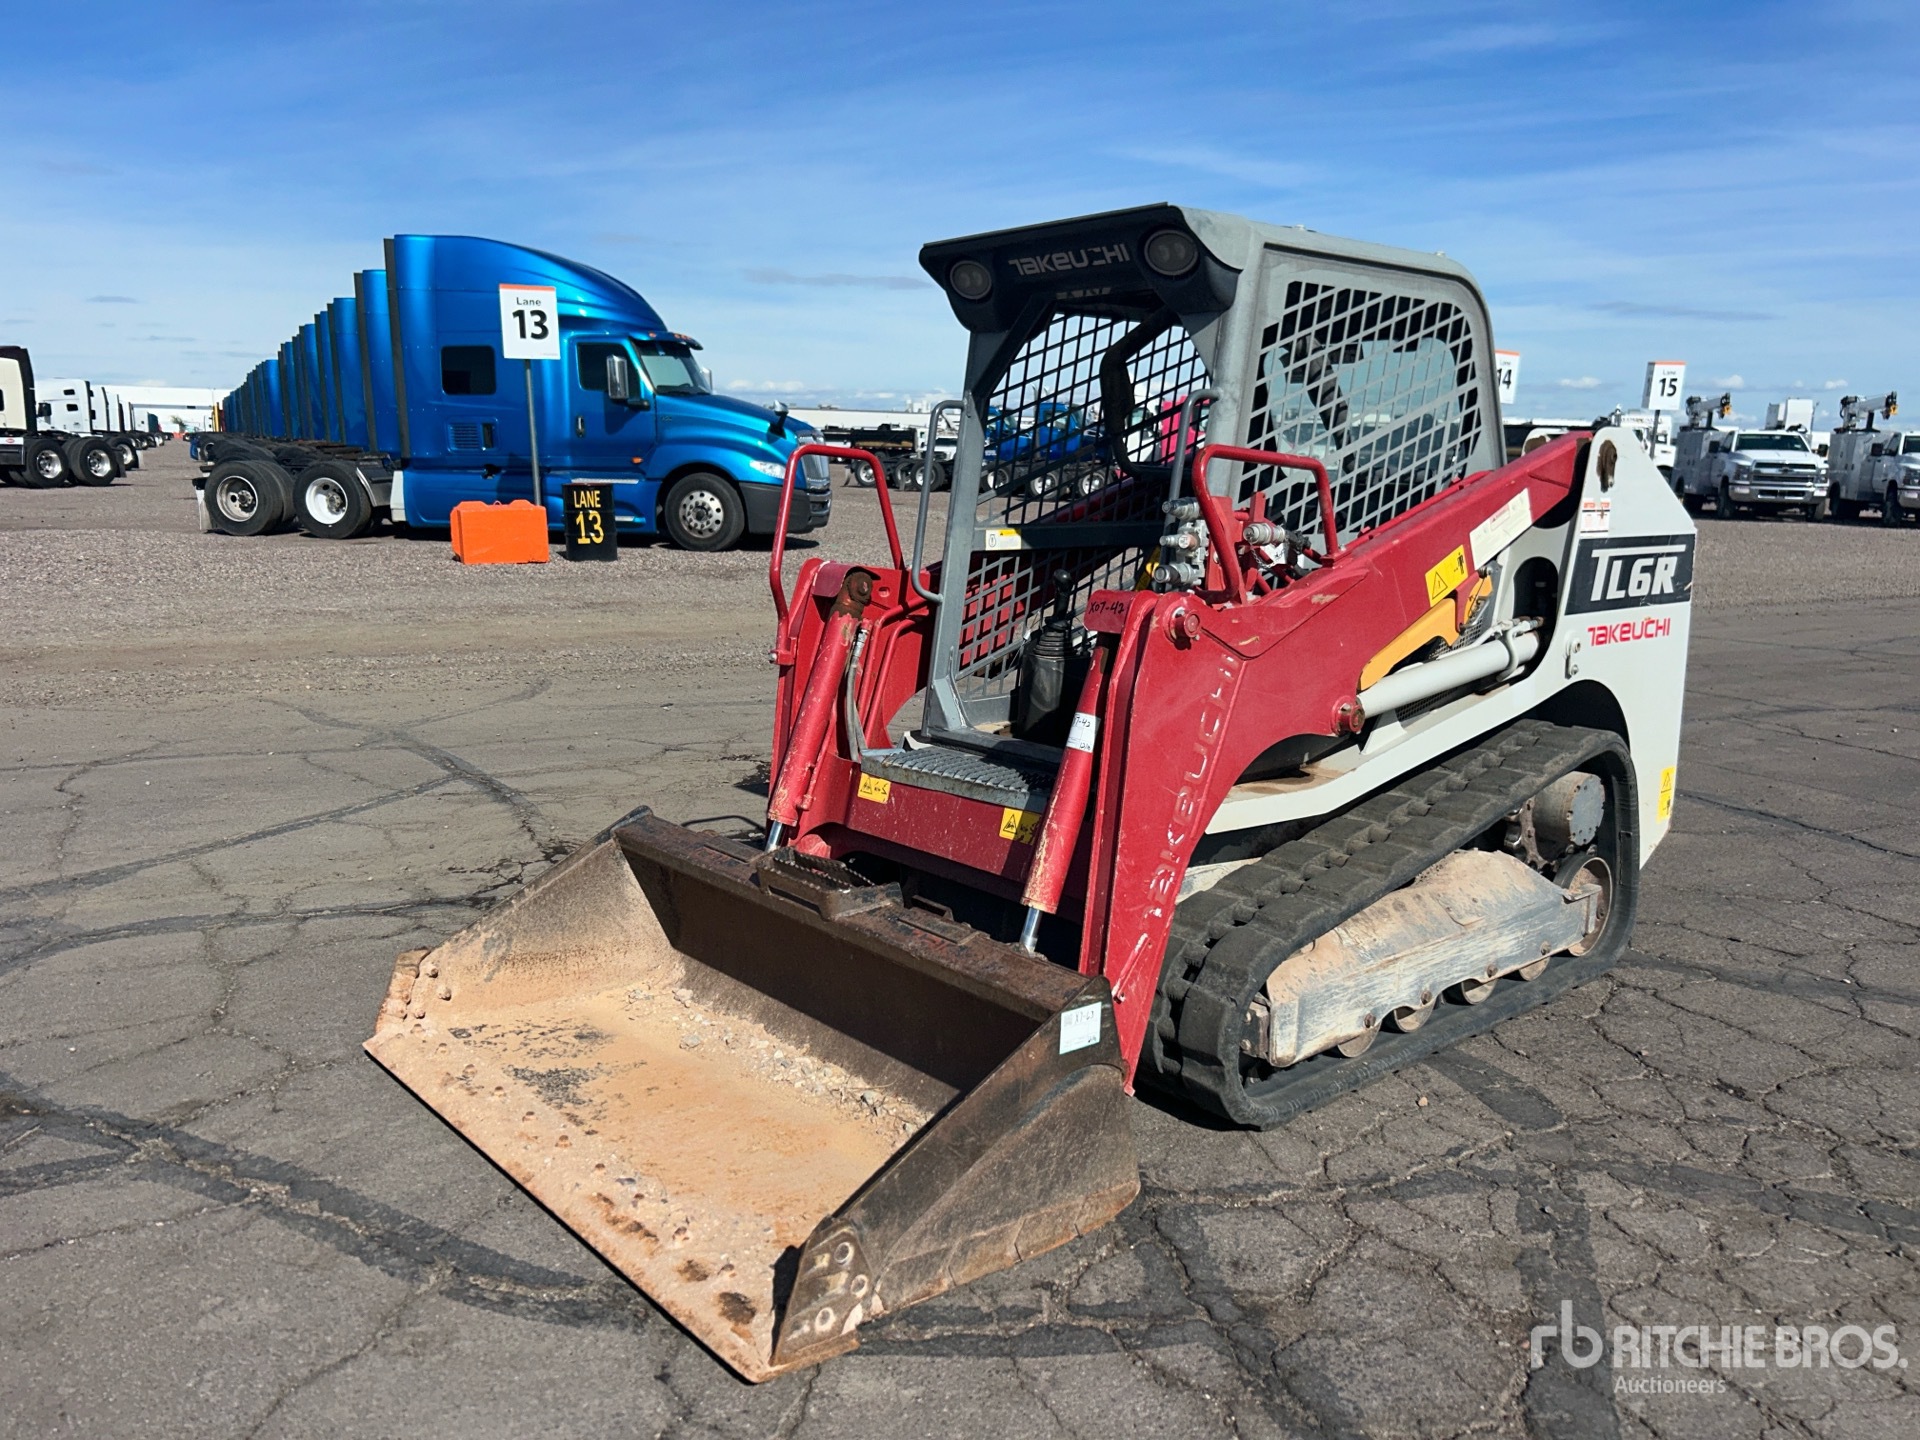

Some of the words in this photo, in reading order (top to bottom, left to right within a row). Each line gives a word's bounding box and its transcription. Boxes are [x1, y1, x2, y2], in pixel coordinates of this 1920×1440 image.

[1008, 243, 1131, 276] TAKEUCHI
[516, 297, 542, 307] Lane
[512, 309, 549, 340] 13
[1659, 377, 1678, 397] 15
[573, 490, 602, 508] LANE
[575, 509, 604, 545] 13
[1590, 544, 1686, 601] TL6R
[1587, 617, 1671, 646] TAKEUCHI
